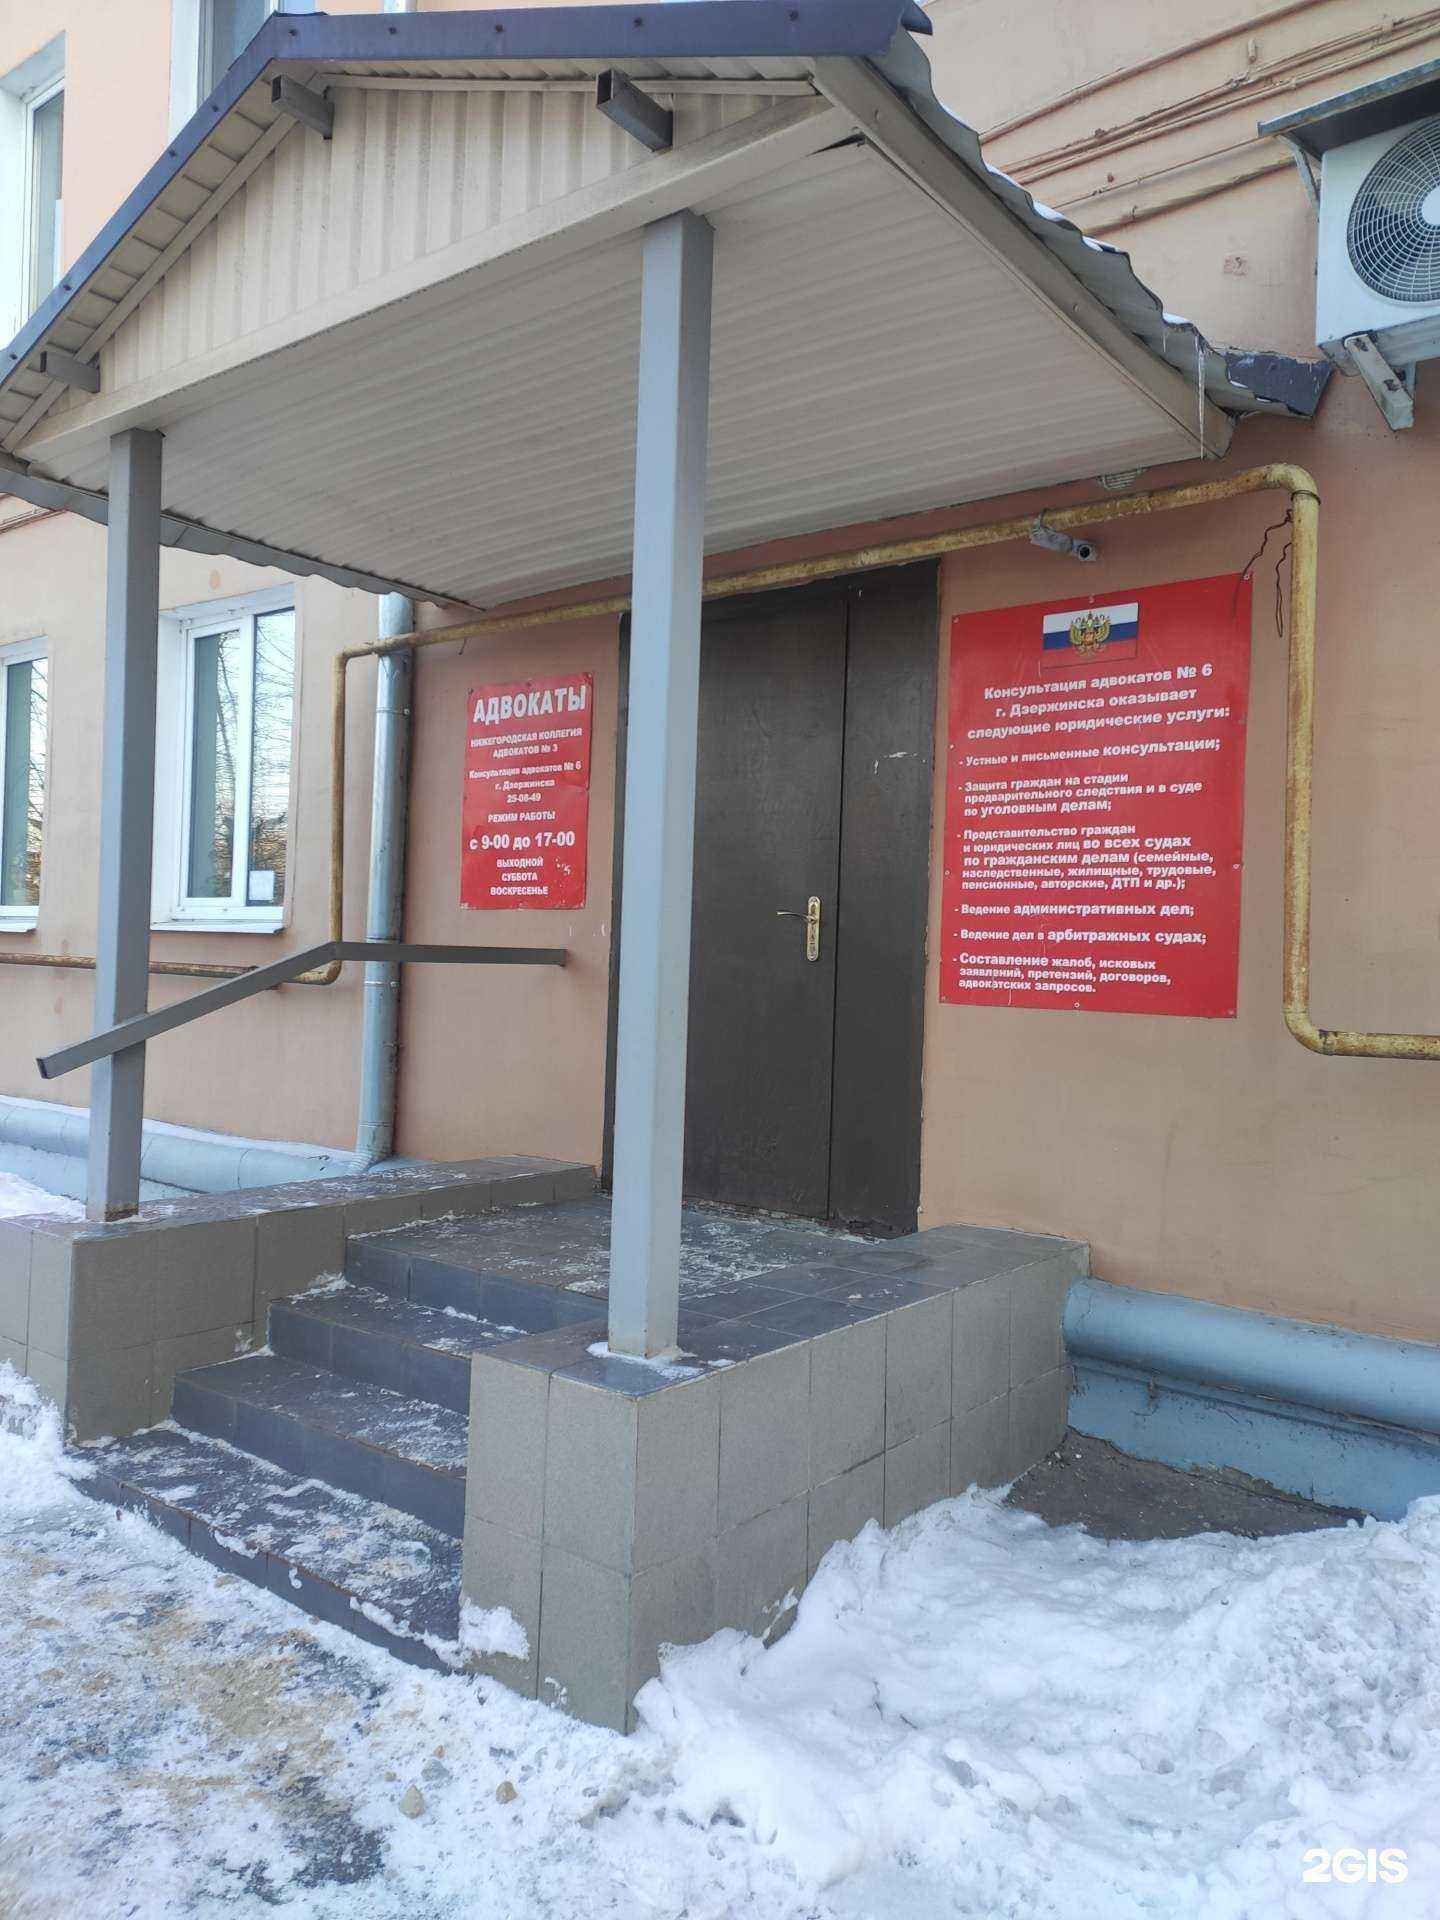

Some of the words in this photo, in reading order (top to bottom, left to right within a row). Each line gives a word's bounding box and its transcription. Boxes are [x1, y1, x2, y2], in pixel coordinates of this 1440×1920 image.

[984, 679, 1087, 699] Консультация
[1090, 670, 1172, 690] адвокатов
[1177, 666, 1197, 679] №
[1202, 663, 1213, 677] 6
[473, 685, 586, 725] АДВОКАТЫ
[995, 708, 1006, 717] г.
[1010, 698, 1104, 717] Дзержинска
[1109, 688, 1197, 706] оказывает
[967, 722, 1051, 739] следующие
[1055, 711, 1162, 732] юридические
[1167, 707, 1230, 725] услуги:
[471, 732, 538, 748] НИЖЕГОРОДСКАЯ
[539, 728, 582, 740] КОЛЛЕГИЯ
[493, 745, 539, 758] АДВОКАТОВ
[541, 744, 551, 753] №
[552, 743, 558, 752] 3
[966, 755, 1008, 767] Устные
[1011, 754, 1019, 763] и
[1021, 747, 1099, 762] письменные
[1103, 738, 1220, 757] консультации;
[469, 767, 520, 779] Консультация
[521, 764, 562, 775] адвокатов
[564, 761, 574, 771] №
[575, 761, 582, 770] 6
[965, 780, 1008, 792] Защита
[1010, 777, 1062, 790] граждан
[1065, 776, 1080, 785] на
[1084, 773, 1129, 786] стадии
[964, 788, 1073, 804] предварительного
[1075, 785, 1143, 797] следствия
[1146, 784, 1155, 793] и
[1159, 784, 1166, 793] в
[1170, 782, 1203, 795] суде
[488, 813, 518, 823] РЕЖИМ
[520, 811, 556, 821] РАБОТЫ
[964, 807, 978, 816] по
[981, 802, 1057, 818] уголовным
[1061, 800, 1112, 813] делам;
[469, 839, 478, 850] с
[481, 834, 510, 850] 9-00
[512, 836, 531, 850] до
[535, 831, 575, 847] 17-00
[963, 826, 1078, 841] Представительство
[1081, 825, 1136, 837] граждан
[963, 844, 971, 853] и
[973, 841, 1053, 854] юридических
[1056, 840, 1080, 850] лиц
[1083, 839, 1101, 849] во
[1104, 838, 1140, 849] всех
[1145, 837, 1192, 850] судах
[496, 856, 544, 868] ВЫХОДНОЙ
[963, 856, 980, 866] по
[984, 854, 1078, 868] гражданским
[1082, 853, 1130, 865] делам
[1133, 851, 1214, 864] (семейные,
[502, 872, 538, 882] СУББОТА
[962, 869, 1064, 881] наследственные,
[1067, 866, 1143, 877] жилищные,
[1147, 865, 1216, 877] трудовые,
[490, 886, 549, 896] ВОСКРЕСЕНЬЕ
[962, 880, 1038, 891] пенсионные,
[1041, 879, 1109, 890] авторские,
[1112, 877, 1140, 889] ДТП
[1144, 879, 1153, 888] и
[1155, 877, 1186, 890] др.);
[961, 904, 1010, 915] Ведение
[1013, 904, 1156, 916] административных
[1160, 905, 1195, 916] дел;
[960, 929, 1009, 940] Ведение
[1012, 931, 1034, 941] дел
[1037, 931, 1044, 940] в
[1047, 929, 1150, 943] арбитражных
[1155, 932, 1207, 945] судах;
[959, 953, 1048, 966] Составление
[1052, 957, 1095, 969] жалоб,
[1099, 959, 1156, 969] исковых
[960, 967, 1024, 979] заявлений,
[1027, 970, 1096, 982] претензий,
[1099, 972, 1171, 985] договоров,
[958, 980, 1031, 990] адвокатских
[1035, 982, 1096, 993] запросов.
